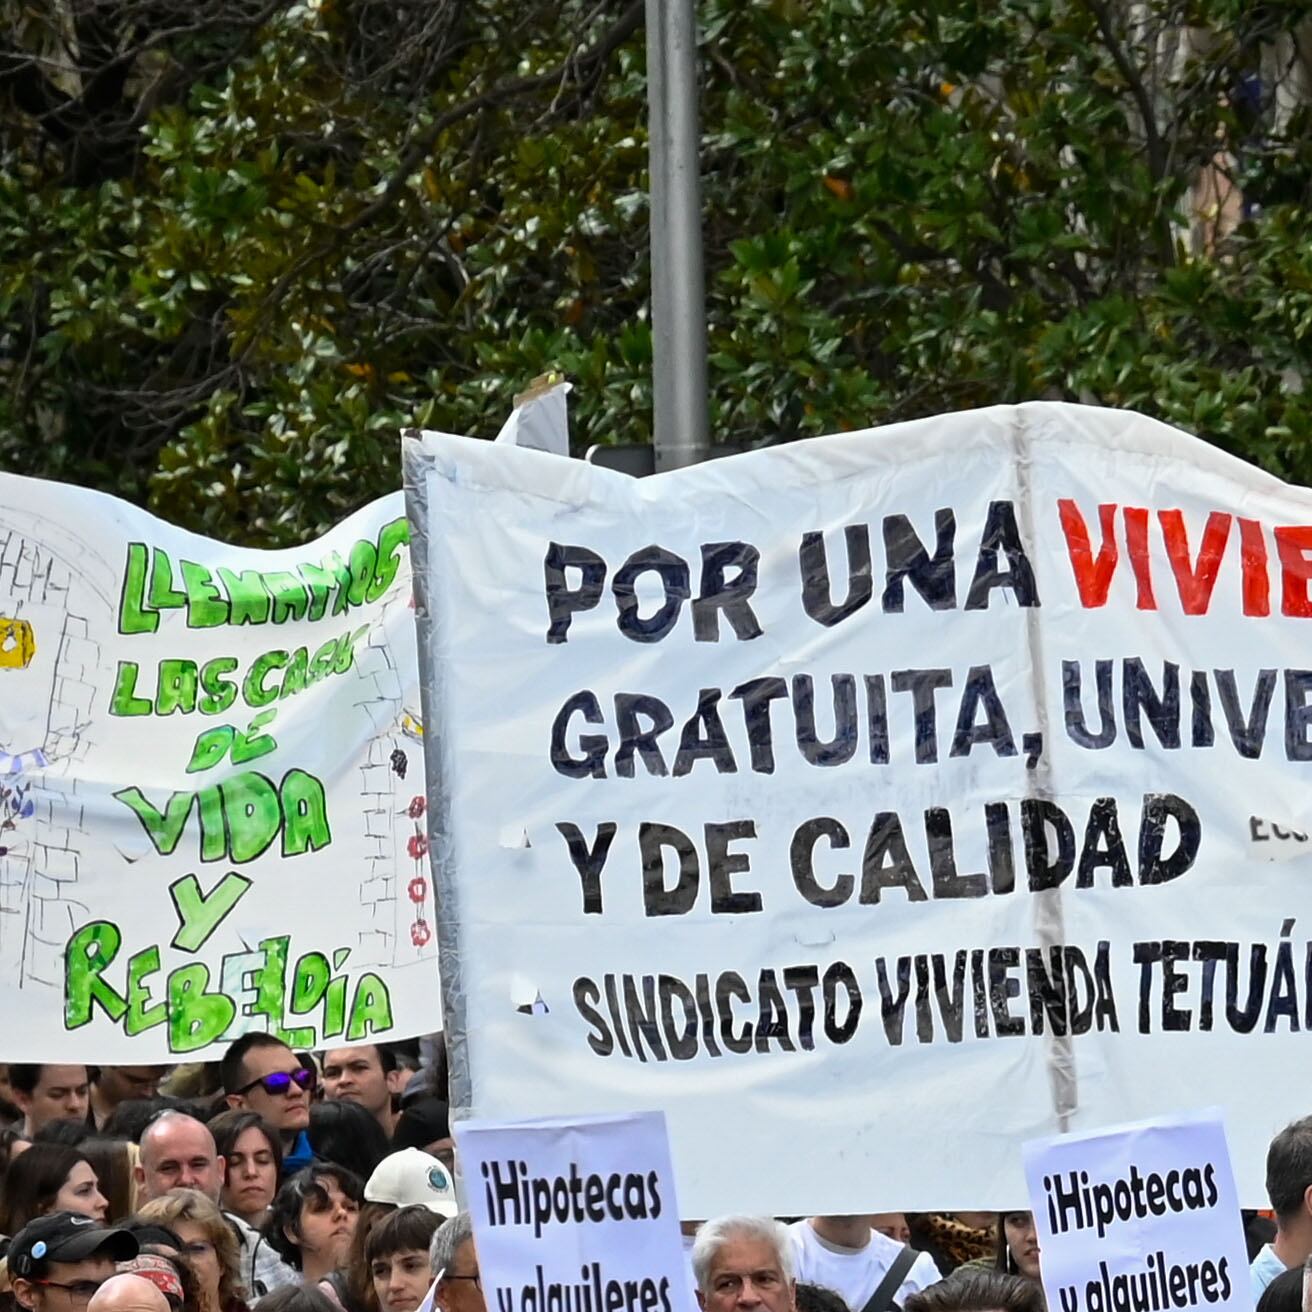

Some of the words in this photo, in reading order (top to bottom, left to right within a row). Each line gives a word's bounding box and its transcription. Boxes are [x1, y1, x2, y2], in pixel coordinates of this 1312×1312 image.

[118, 515, 410, 635] LLENAMOS
[545, 541, 764, 644] POR
[799, 500, 1041, 627] UNA
[109, 657, 240, 717] LAS
[550, 664, 1043, 779] GRATUITA,
[186, 709, 279, 774] DE
[112, 767, 333, 865] VIDA
[555, 821, 618, 915] Y
[638, 819, 764, 917] DE
[789, 792, 1202, 909] CALIDAD
[168, 871, 254, 953] Y
[63, 919, 395, 1054] REBELDÍA
[572, 961, 863, 1063] SINDICATO
[875, 939, 1120, 1047] VIVIENDA
[480, 1159, 662, 1239] ¡Hipotecas
[1043, 1162, 1219, 1239] ¡Hipotecas
